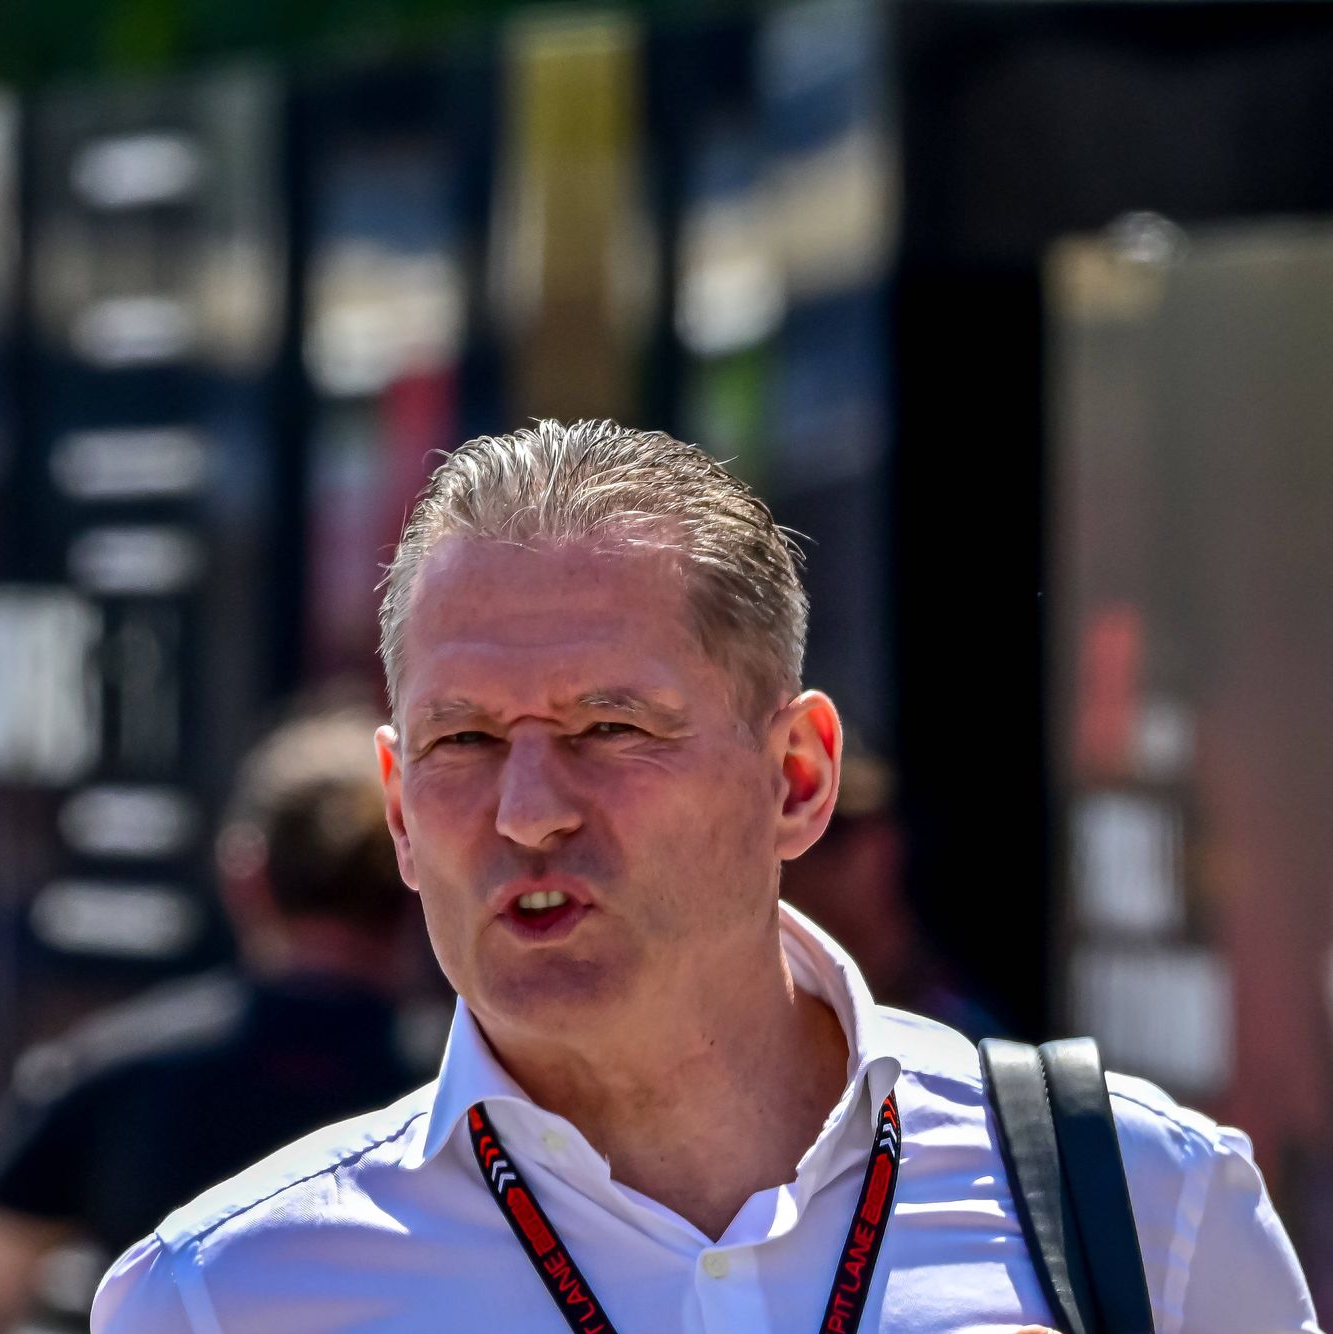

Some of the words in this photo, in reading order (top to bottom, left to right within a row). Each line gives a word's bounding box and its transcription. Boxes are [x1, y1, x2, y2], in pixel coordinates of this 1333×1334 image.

[543, 1251, 596, 1322] LANE
[828, 1297, 854, 1334] PIT
[843, 1223, 876, 1294] LANE
